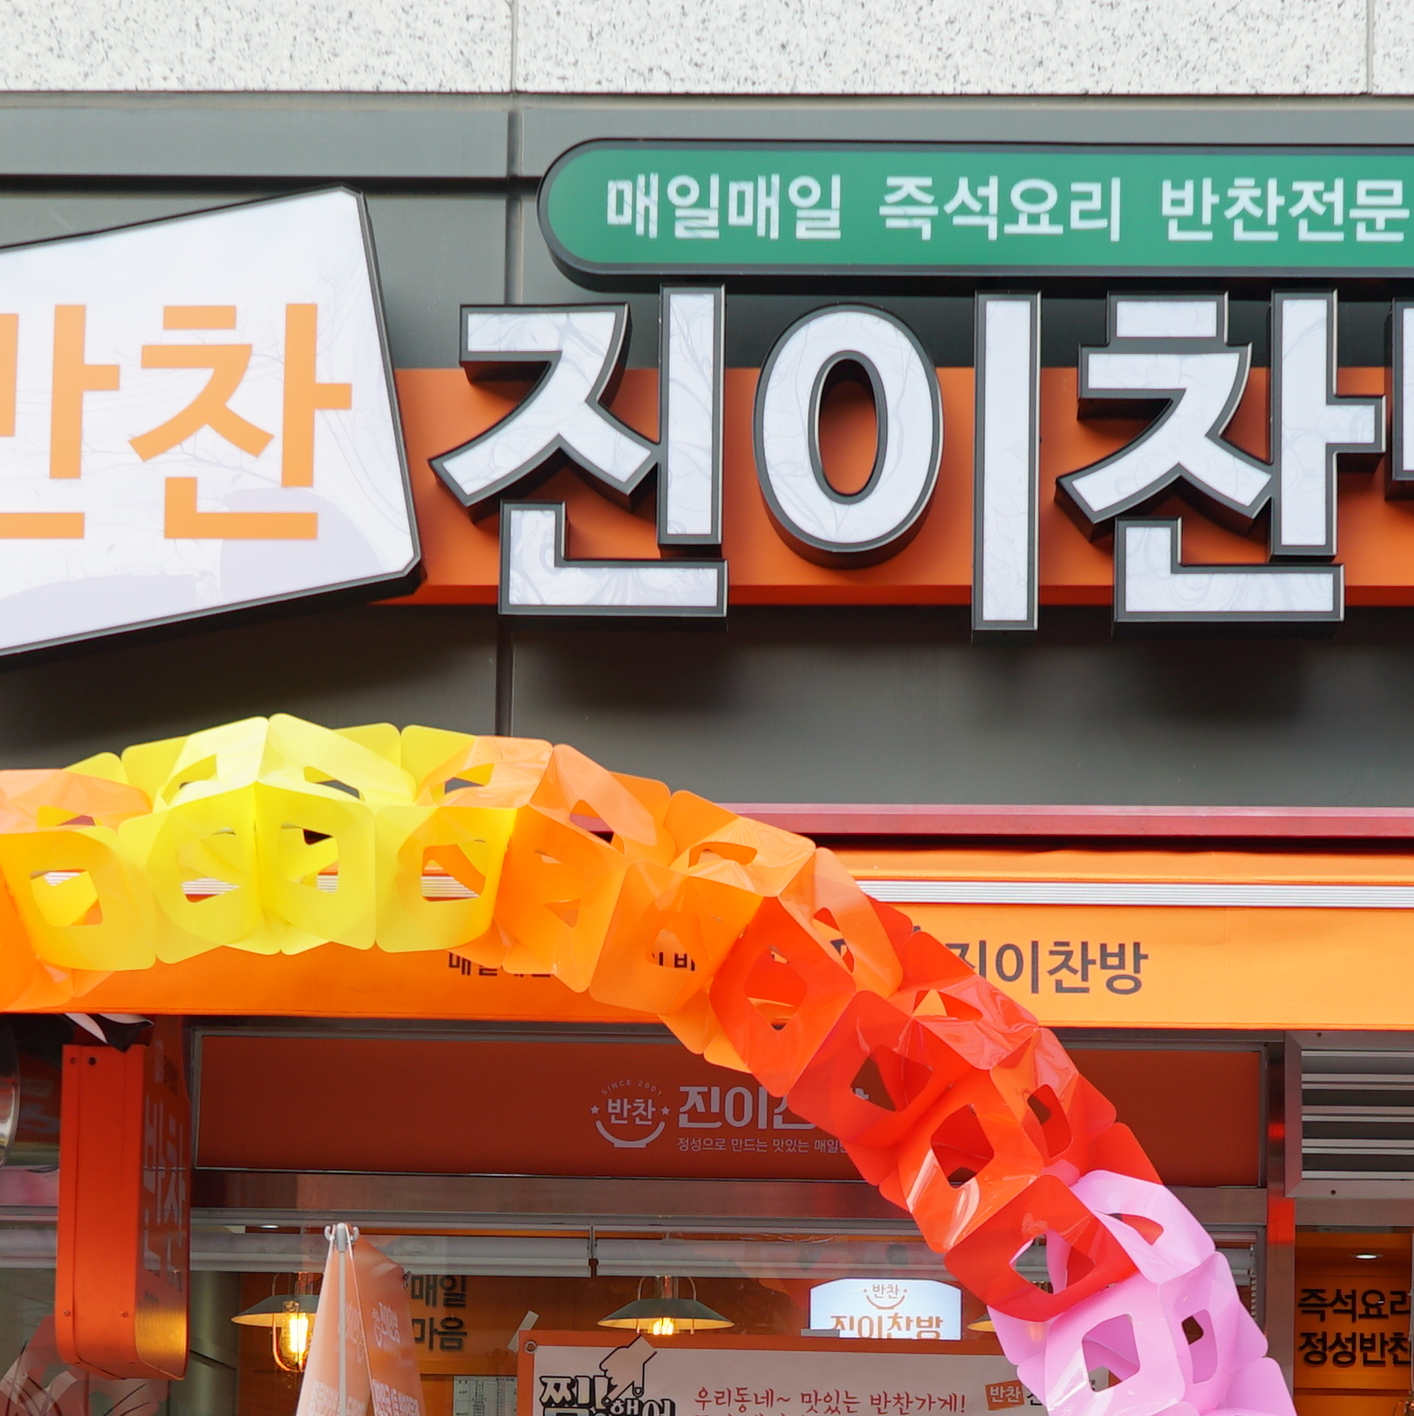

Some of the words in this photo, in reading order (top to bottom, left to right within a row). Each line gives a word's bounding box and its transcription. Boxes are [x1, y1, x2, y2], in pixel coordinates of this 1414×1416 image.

[606, 174, 844, 241] 매일매일
[878, 176, 1123, 243] 즉석요리
[607, 1098, 656, 1125] 반찬
[677, 1137, 727, 1152] 정성으로
[731, 1138, 768, 1153] 만드는
[773, 1138, 809, 1153] 맛있는
[872, 1283, 900, 1300] 반찬
[1298, 1288, 1414, 1323] 즉석요리
[800, 1389, 861, 1415] 맛있는
[870, 1391, 967, 1416] 반찬가게!
[990, 1386, 1022, 1404] 반찬
